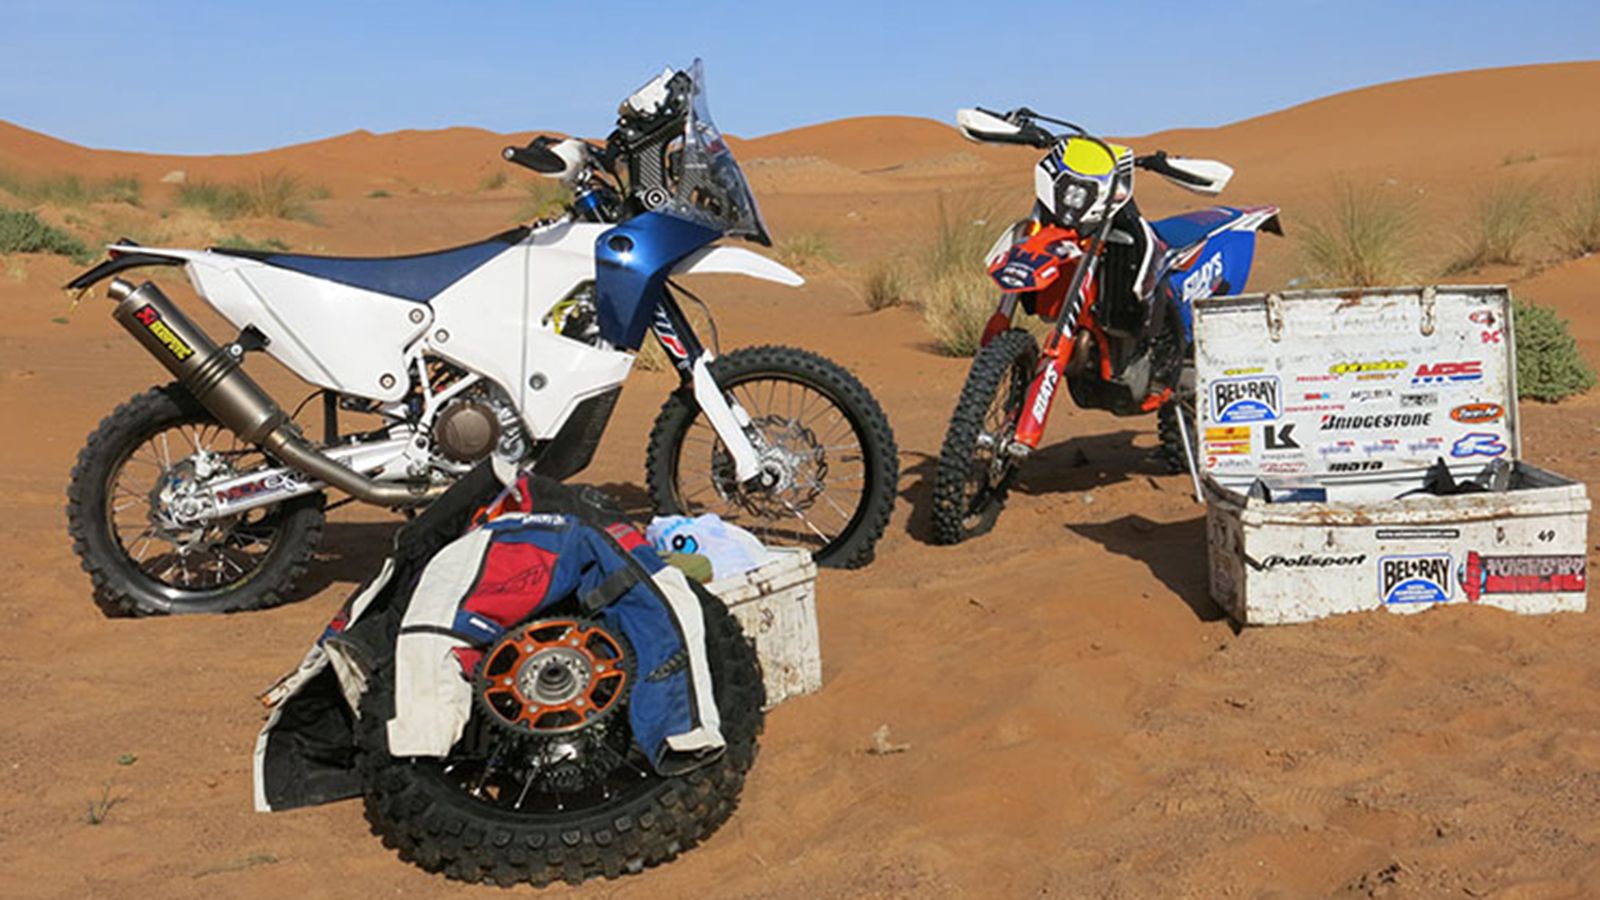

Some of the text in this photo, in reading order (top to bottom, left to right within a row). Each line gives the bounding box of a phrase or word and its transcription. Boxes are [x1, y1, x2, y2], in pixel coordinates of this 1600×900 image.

[1320, 413, 1432, 430] BRIDGESTONE
[1537, 529, 1556, 542] 49
[1262, 552, 1367, 570] Polisport
